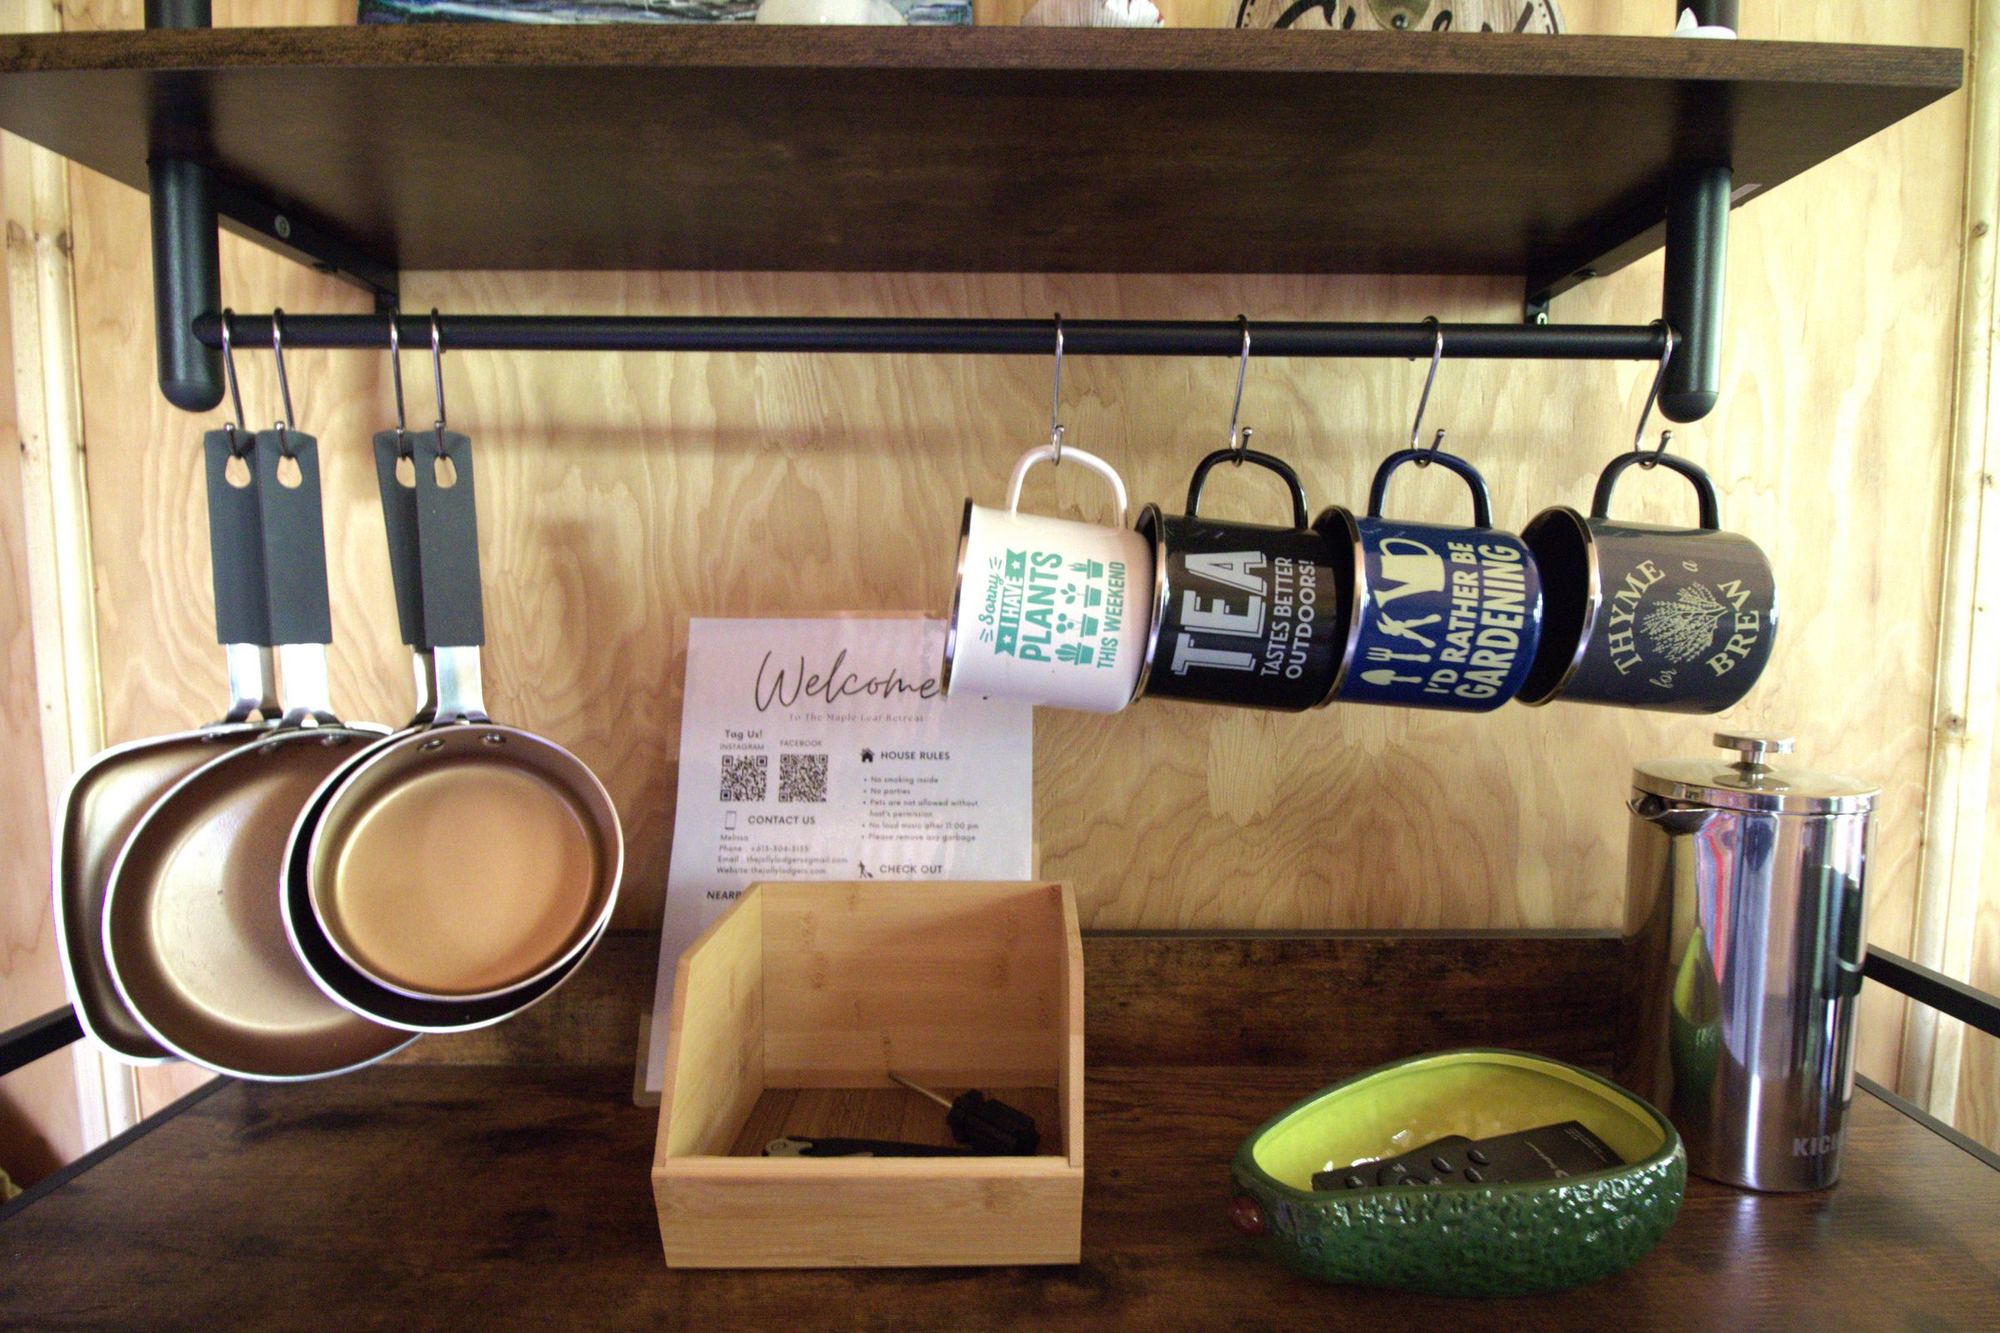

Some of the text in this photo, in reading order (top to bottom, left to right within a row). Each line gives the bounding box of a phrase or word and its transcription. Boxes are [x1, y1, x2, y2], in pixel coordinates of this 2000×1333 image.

[978, 573, 1004, 625] Sorry
[1001, 575, 1023, 617] HAVE
[1019, 551, 1063, 662] PLANTS
[1096, 561, 1126, 668] THIS WEEKEND
[1171, 550, 1268, 676] TEA
[1260, 556, 1294, 676] TASTES BETTER
[1285, 560, 1316, 680] OUTDOORS!
[1424, 541, 1480, 694] I'D RATHER BE
[1454, 544, 1527, 699] GARDENING
[1608, 559, 1666, 676] THYME
[1705, 578, 1760, 677] BREW
[755, 648, 942, 713] Welcome
[725, 729, 744, 741] Tag
[880, 751, 951, 760] HOUSE RULES
[870, 787, 911, 796] No parties
[884, 776, 914, 785] smoking
[918, 799, 949, 807] allowed
[747, 815, 816, 825] CONTACT US
[879, 864, 943, 875] CHECK OUT
[1792, 1135, 1838, 1157] KIC
